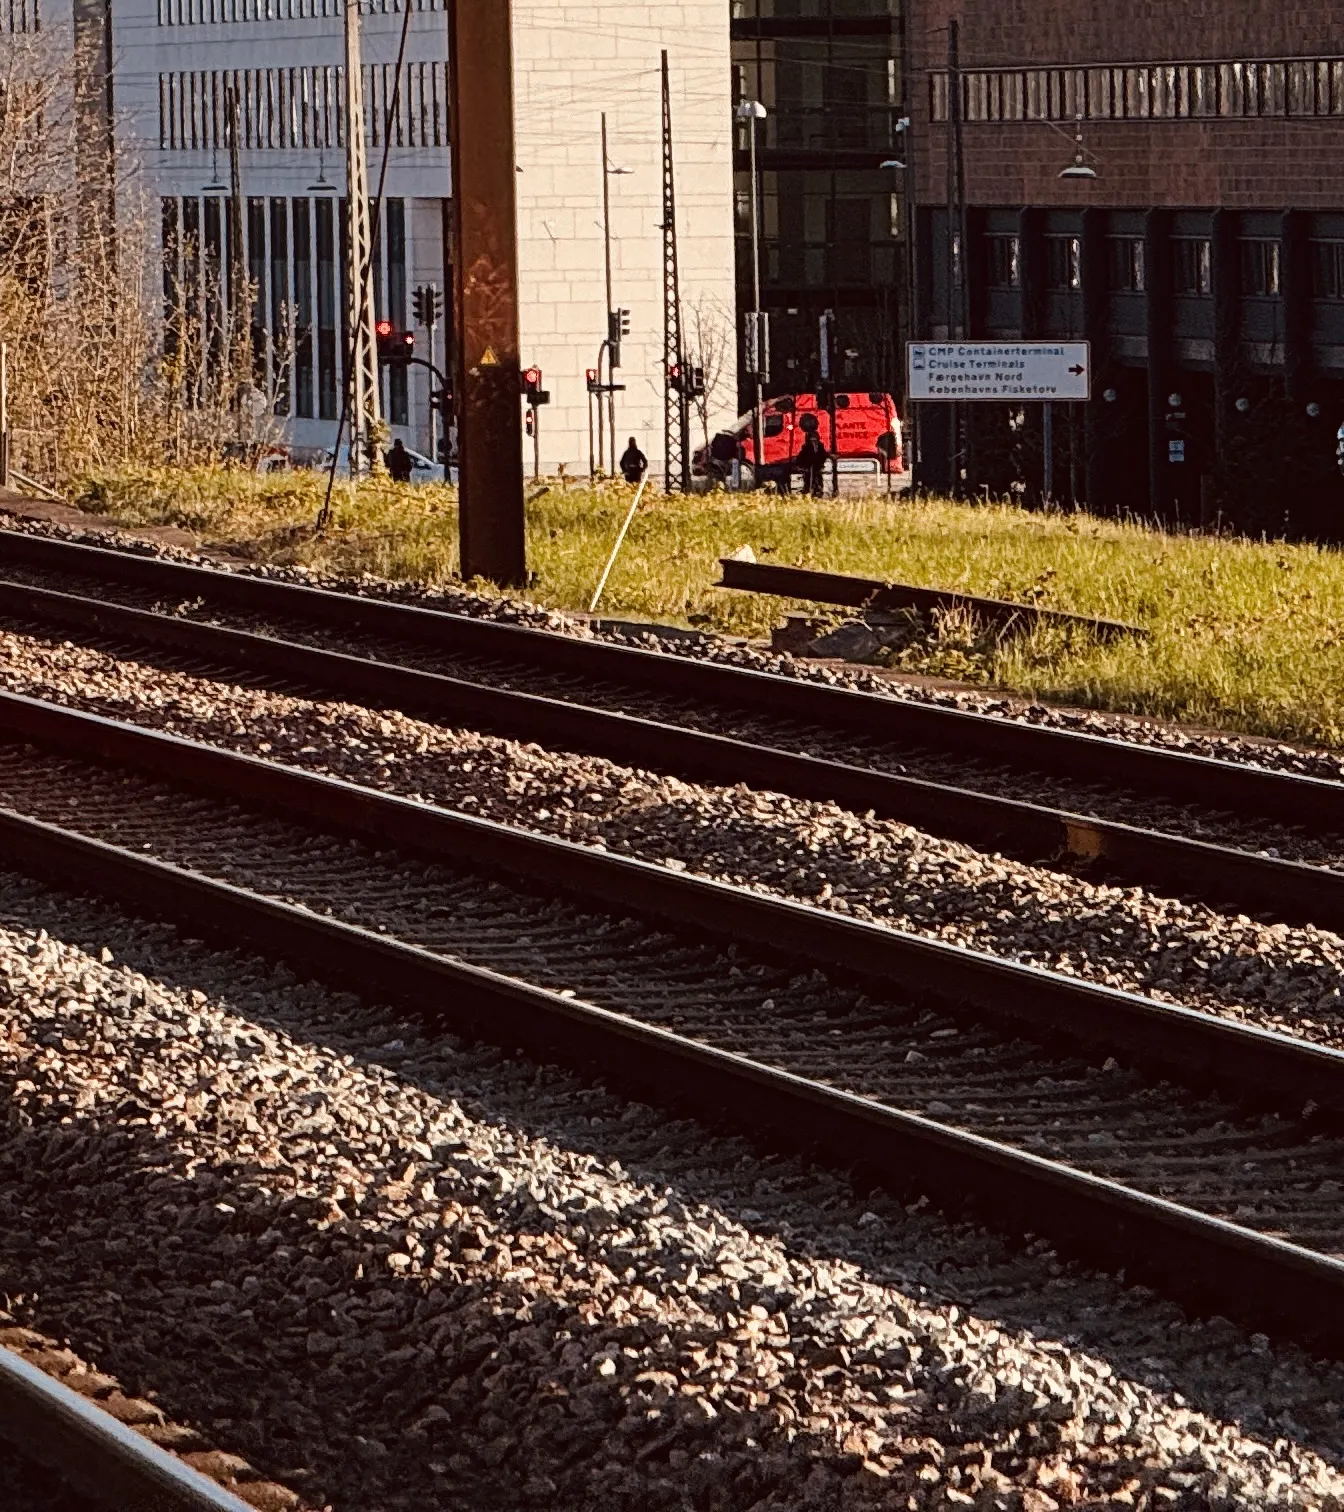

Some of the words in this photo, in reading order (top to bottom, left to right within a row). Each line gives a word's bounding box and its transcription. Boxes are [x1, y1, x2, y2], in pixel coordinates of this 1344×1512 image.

[928, 347, 954, 356] CMP
[958, 346, 1064, 356] Containerterminal
[928, 359, 966, 368] Cruise
[969, 359, 1025, 368] Terminals
[928, 372, 991, 383] Færgehavn
[995, 372, 1023, 381] Nord
[928, 384, 998, 394] Københavns
